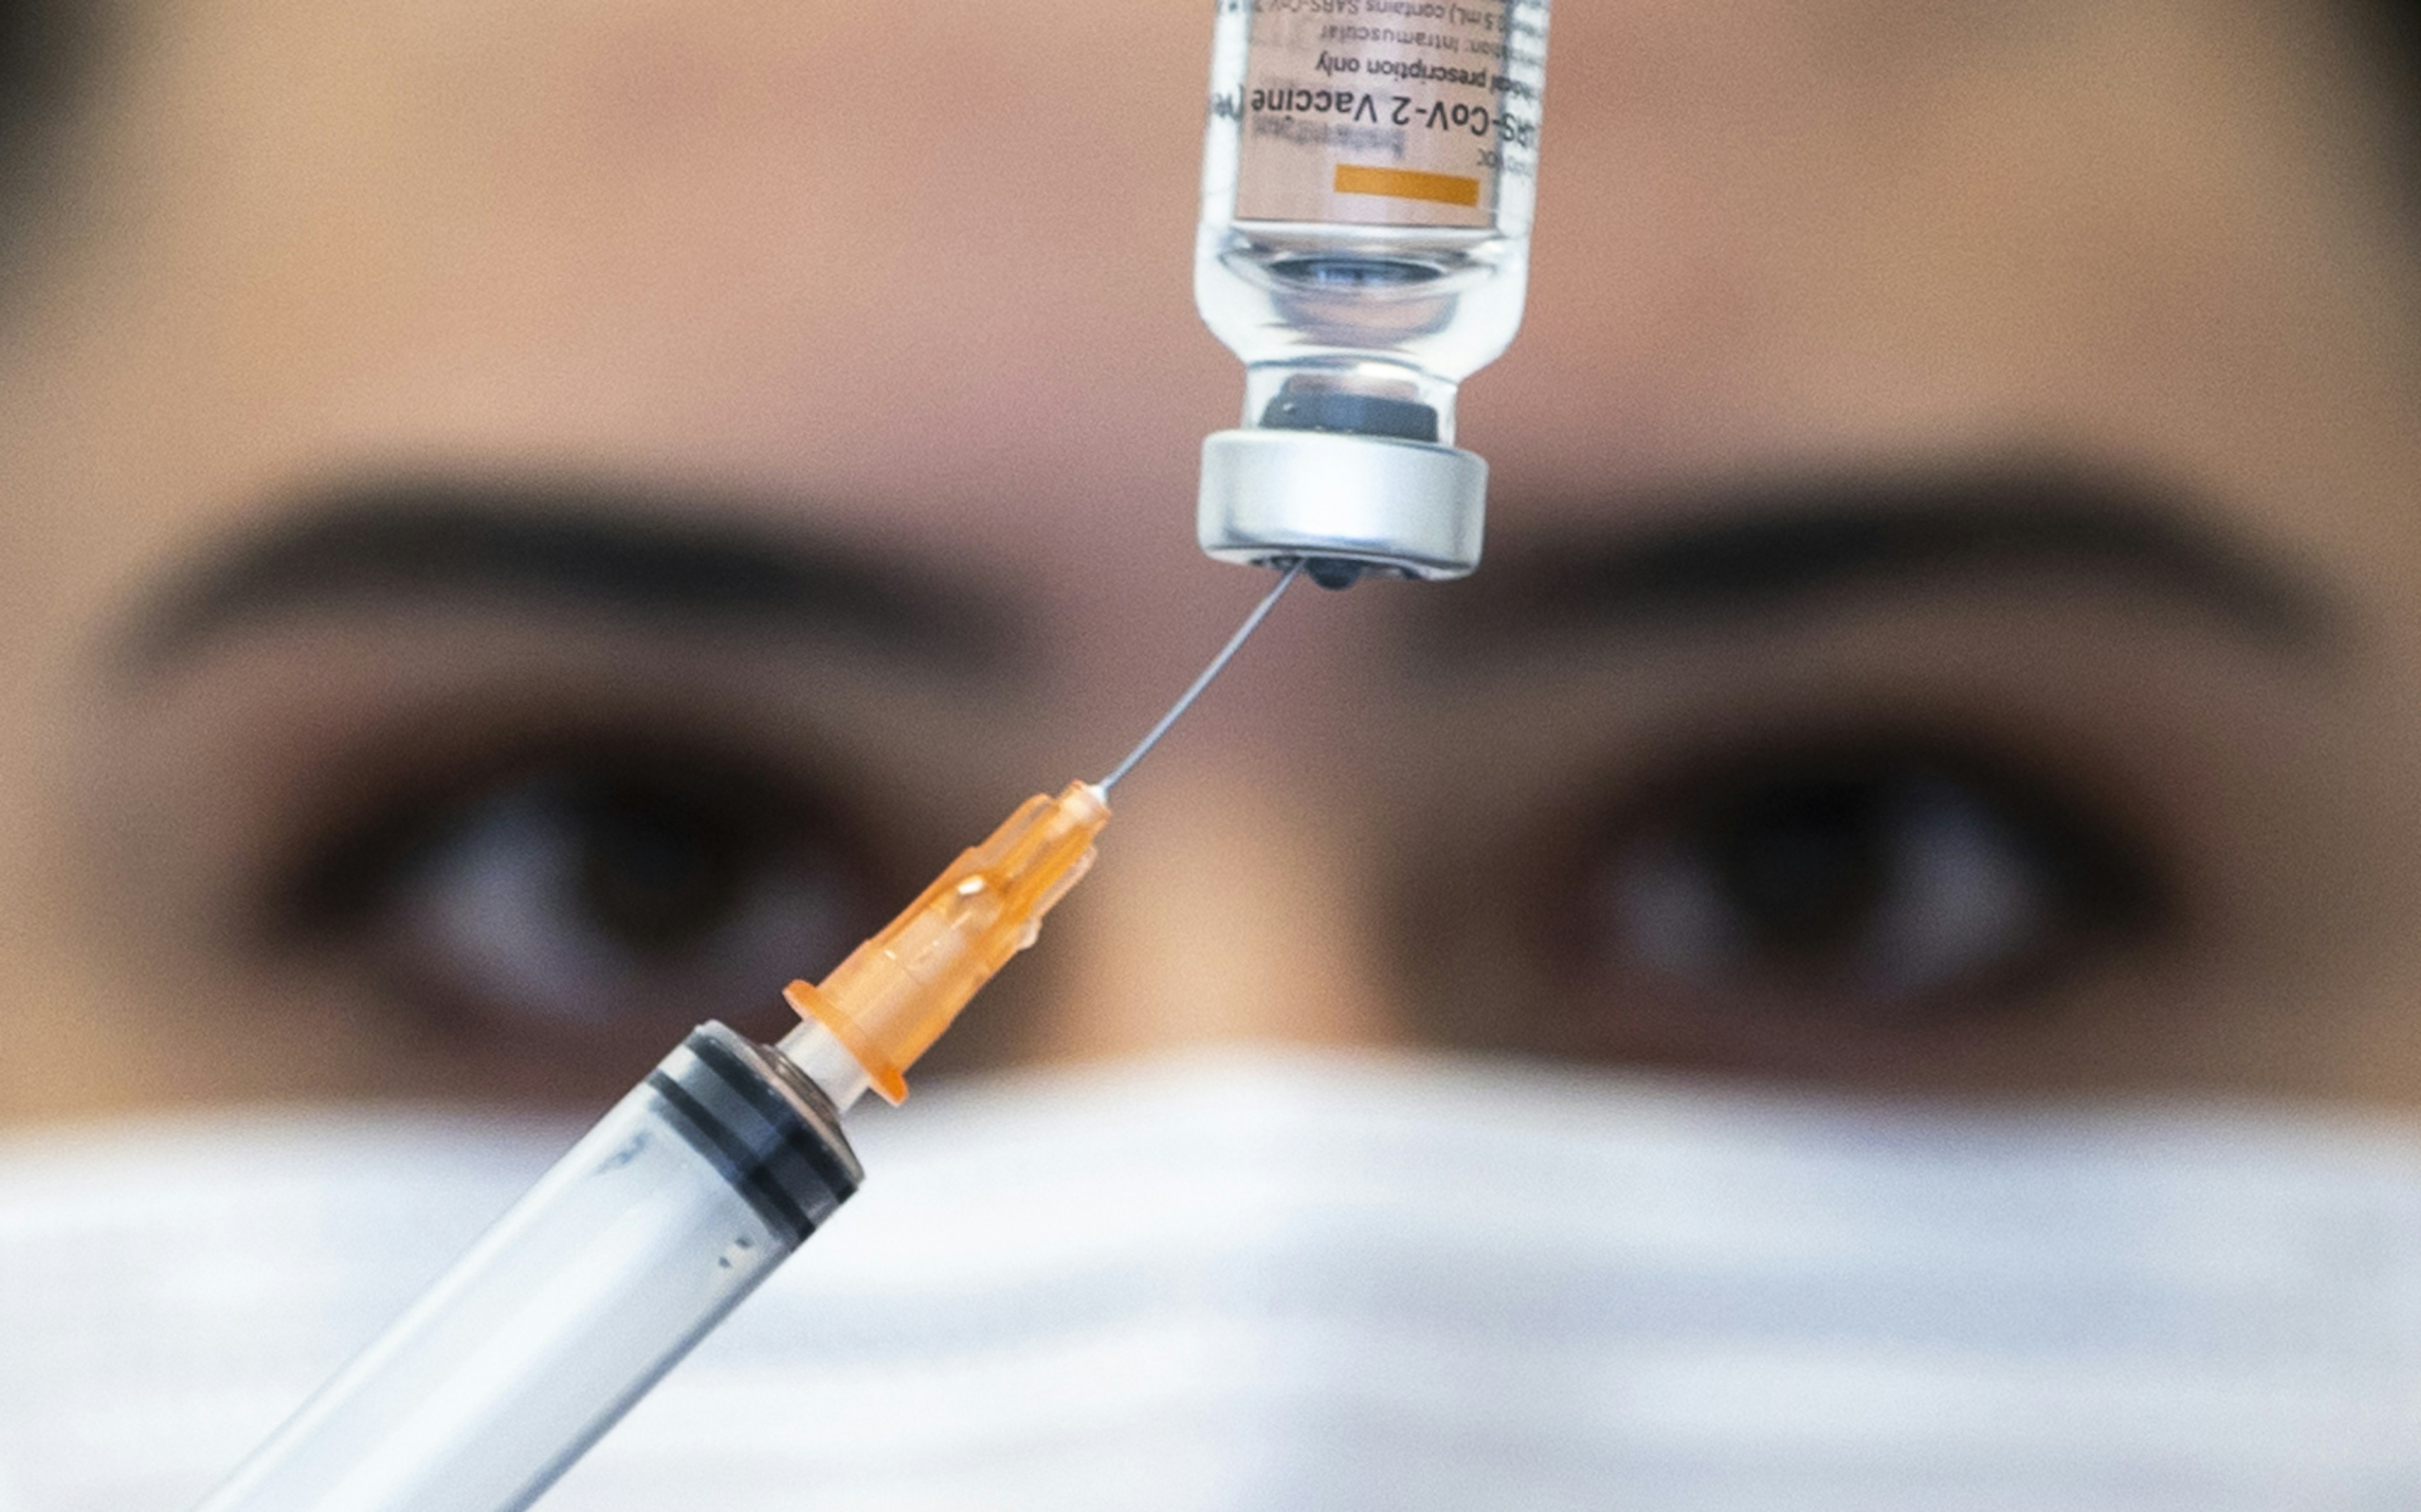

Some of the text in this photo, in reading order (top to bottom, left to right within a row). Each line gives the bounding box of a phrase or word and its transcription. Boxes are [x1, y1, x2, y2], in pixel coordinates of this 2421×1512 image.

[1366, 0, 1446, 18] contains
[1321, 25, 1459, 52] Intramuscular
[1315, 50, 1361, 76] only
[1366, 59, 1488, 88] prescription
[1251, 89, 1378, 123] Vaccine
